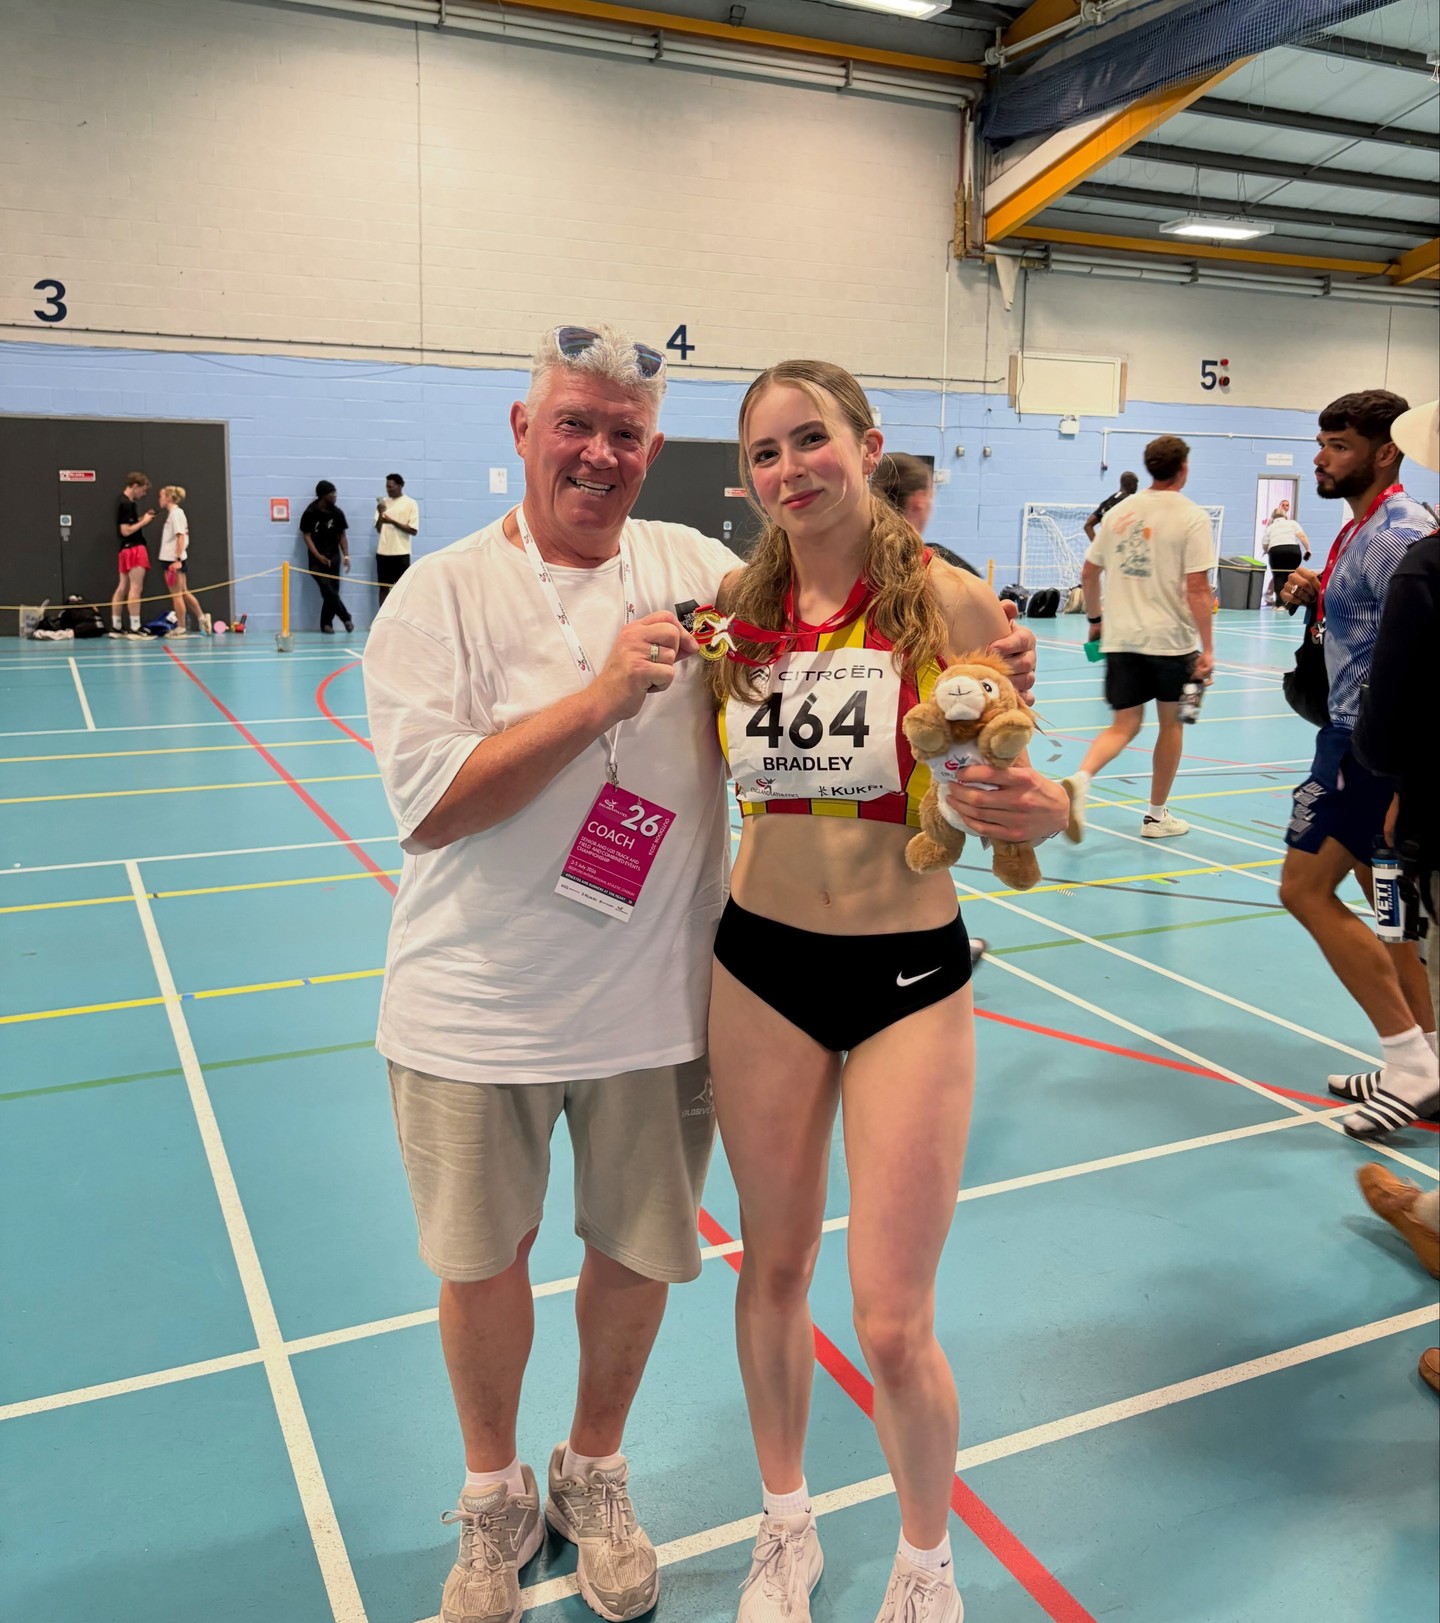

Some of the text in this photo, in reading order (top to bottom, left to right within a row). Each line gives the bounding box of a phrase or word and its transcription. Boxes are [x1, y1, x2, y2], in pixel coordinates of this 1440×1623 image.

[33, 279, 67, 322] 3
[666, 324, 695, 361] 4
[1200, 359, 1218, 390] 5
[778, 665, 883, 682] CITROËN
[746, 690, 869, 749] 464
[763, 756, 854, 771] BRADLEY
[587, 821, 636, 850] COACH
[621, 804, 663, 837] 26
[654, 818, 670, 844] OUTDOOR
[576, 846, 611, 864] CHAMPIONSHIP
[579, 841, 641, 872] FIELD AND COMBINED EVENTS
[581, 836, 598, 846] SENIOR
[597, 843, 608, 851] AND
[615, 851, 630, 861] TRACK
[1376, 883, 1390, 922] YETI
